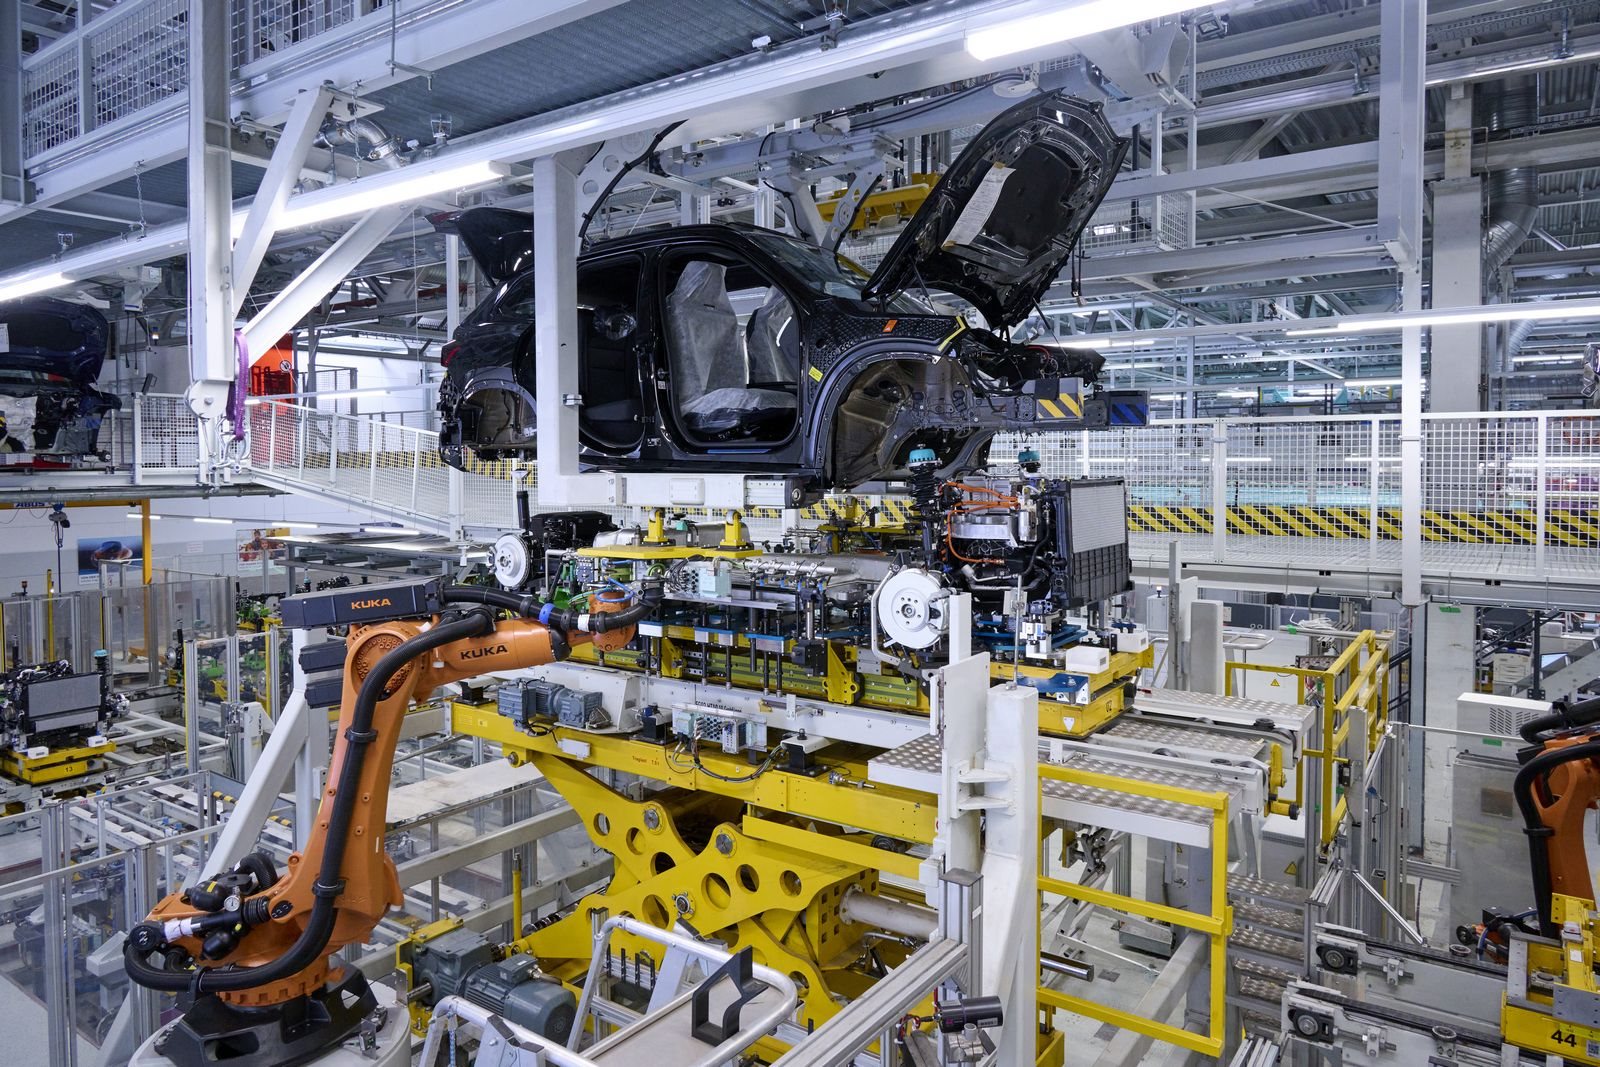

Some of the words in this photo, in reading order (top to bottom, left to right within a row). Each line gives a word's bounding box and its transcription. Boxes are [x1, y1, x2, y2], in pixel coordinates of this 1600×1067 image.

[351, 598, 392, 610] KUKA
[460, 644, 508, 660] KUKA
[1551, 1029, 1577, 1047] 44
